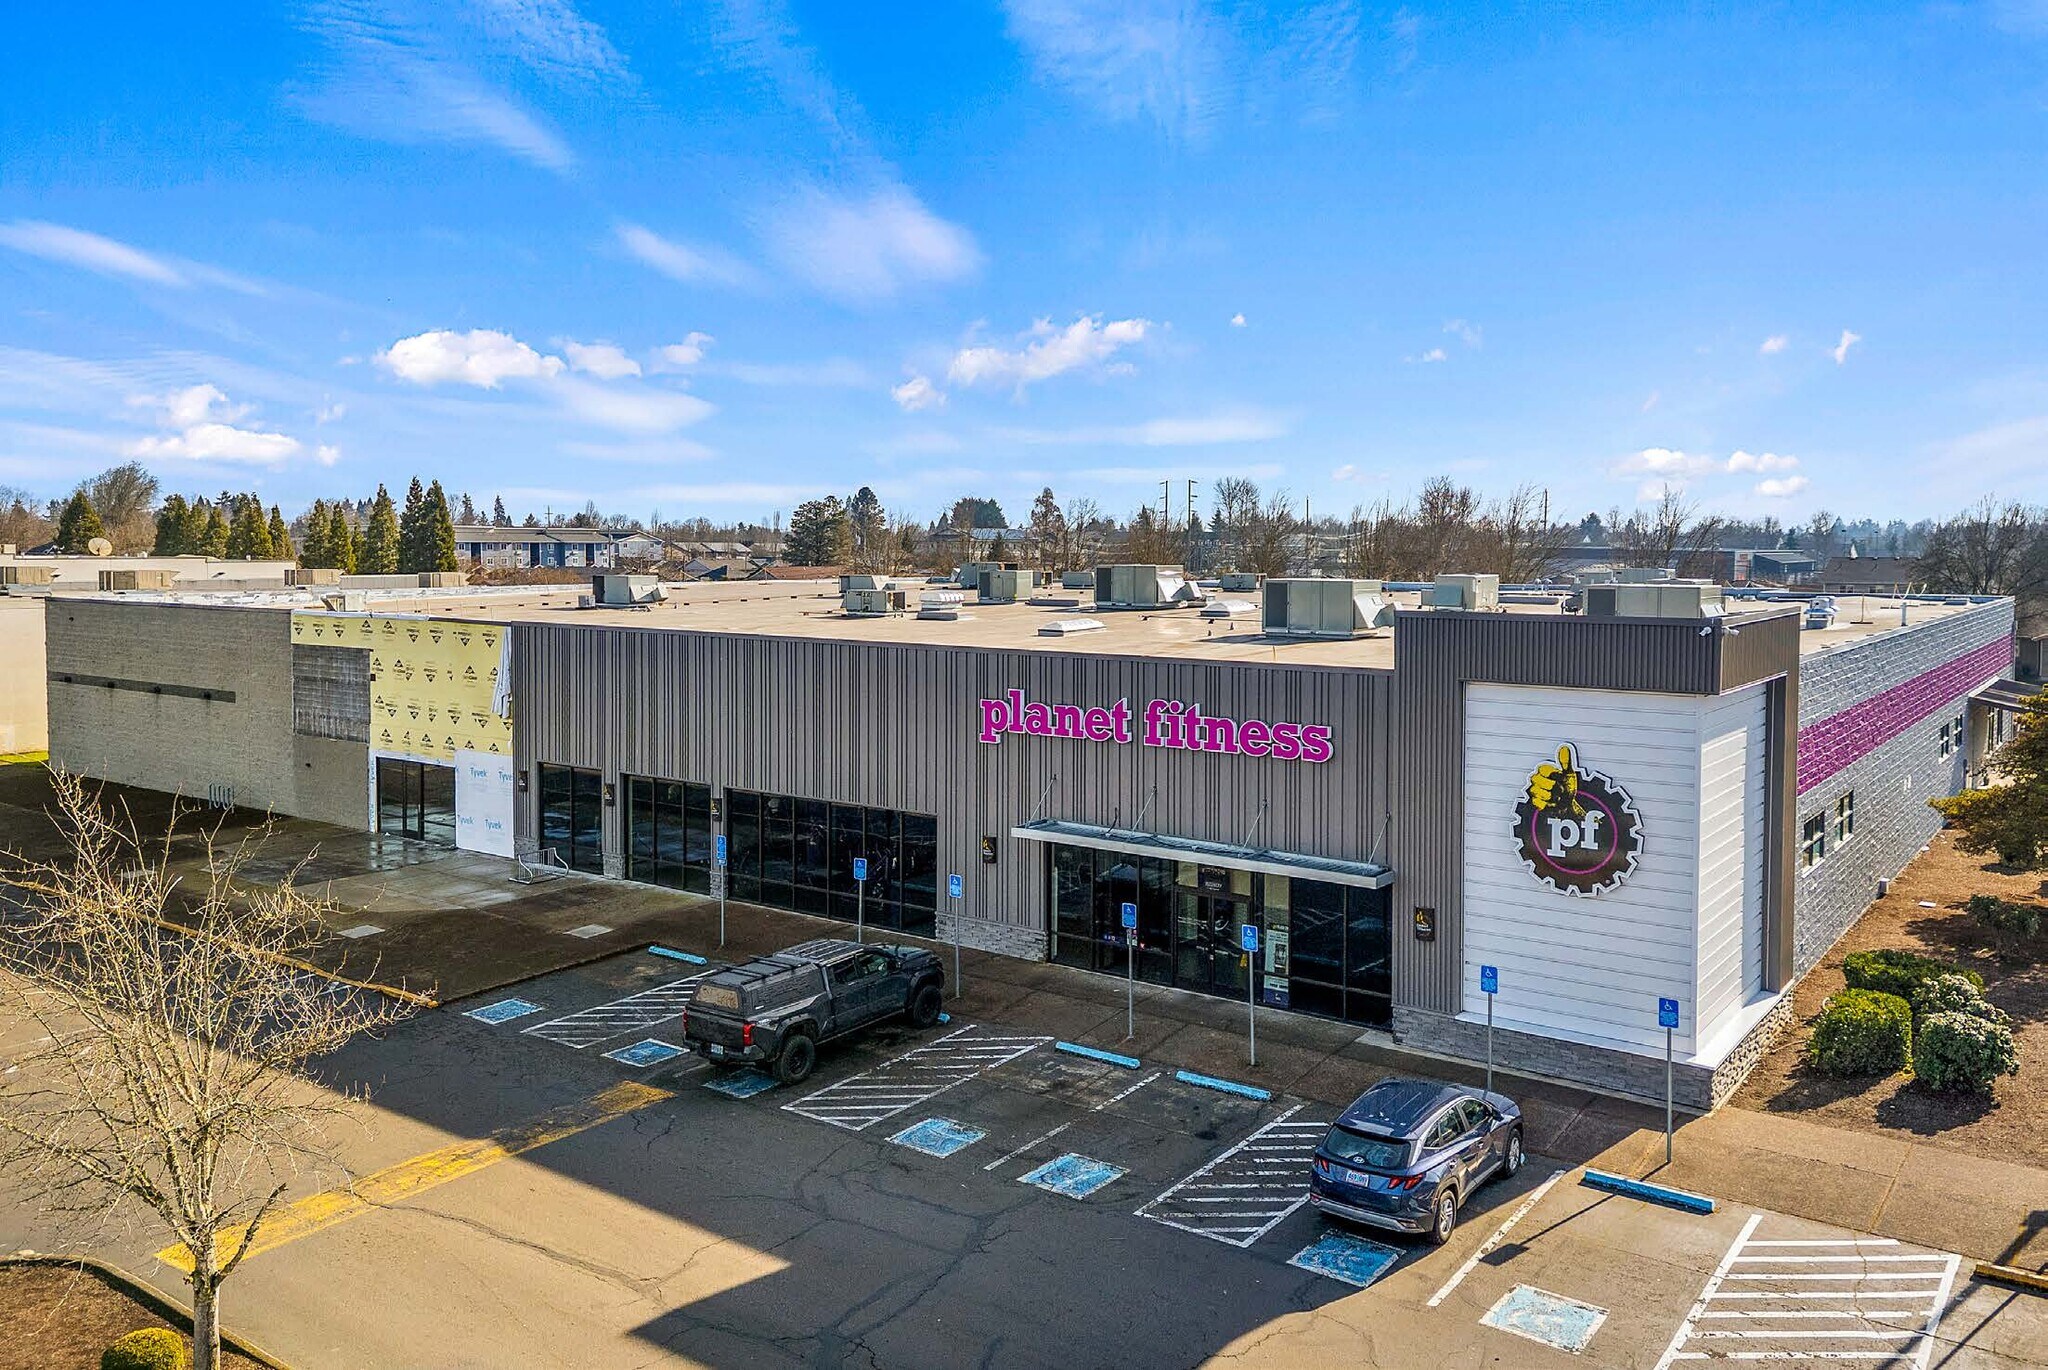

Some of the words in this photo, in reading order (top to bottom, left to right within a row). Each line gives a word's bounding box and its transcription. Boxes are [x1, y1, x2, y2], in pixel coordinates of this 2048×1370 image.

[980, 689, 1132, 744] planet
[1144, 698, 1334, 763] fitness
[469, 767, 488, 778] Tyvek
[498, 771, 513, 782] Tyve
[485, 819, 502, 830] Tyvek
[1547, 810, 1605, 858] pf
